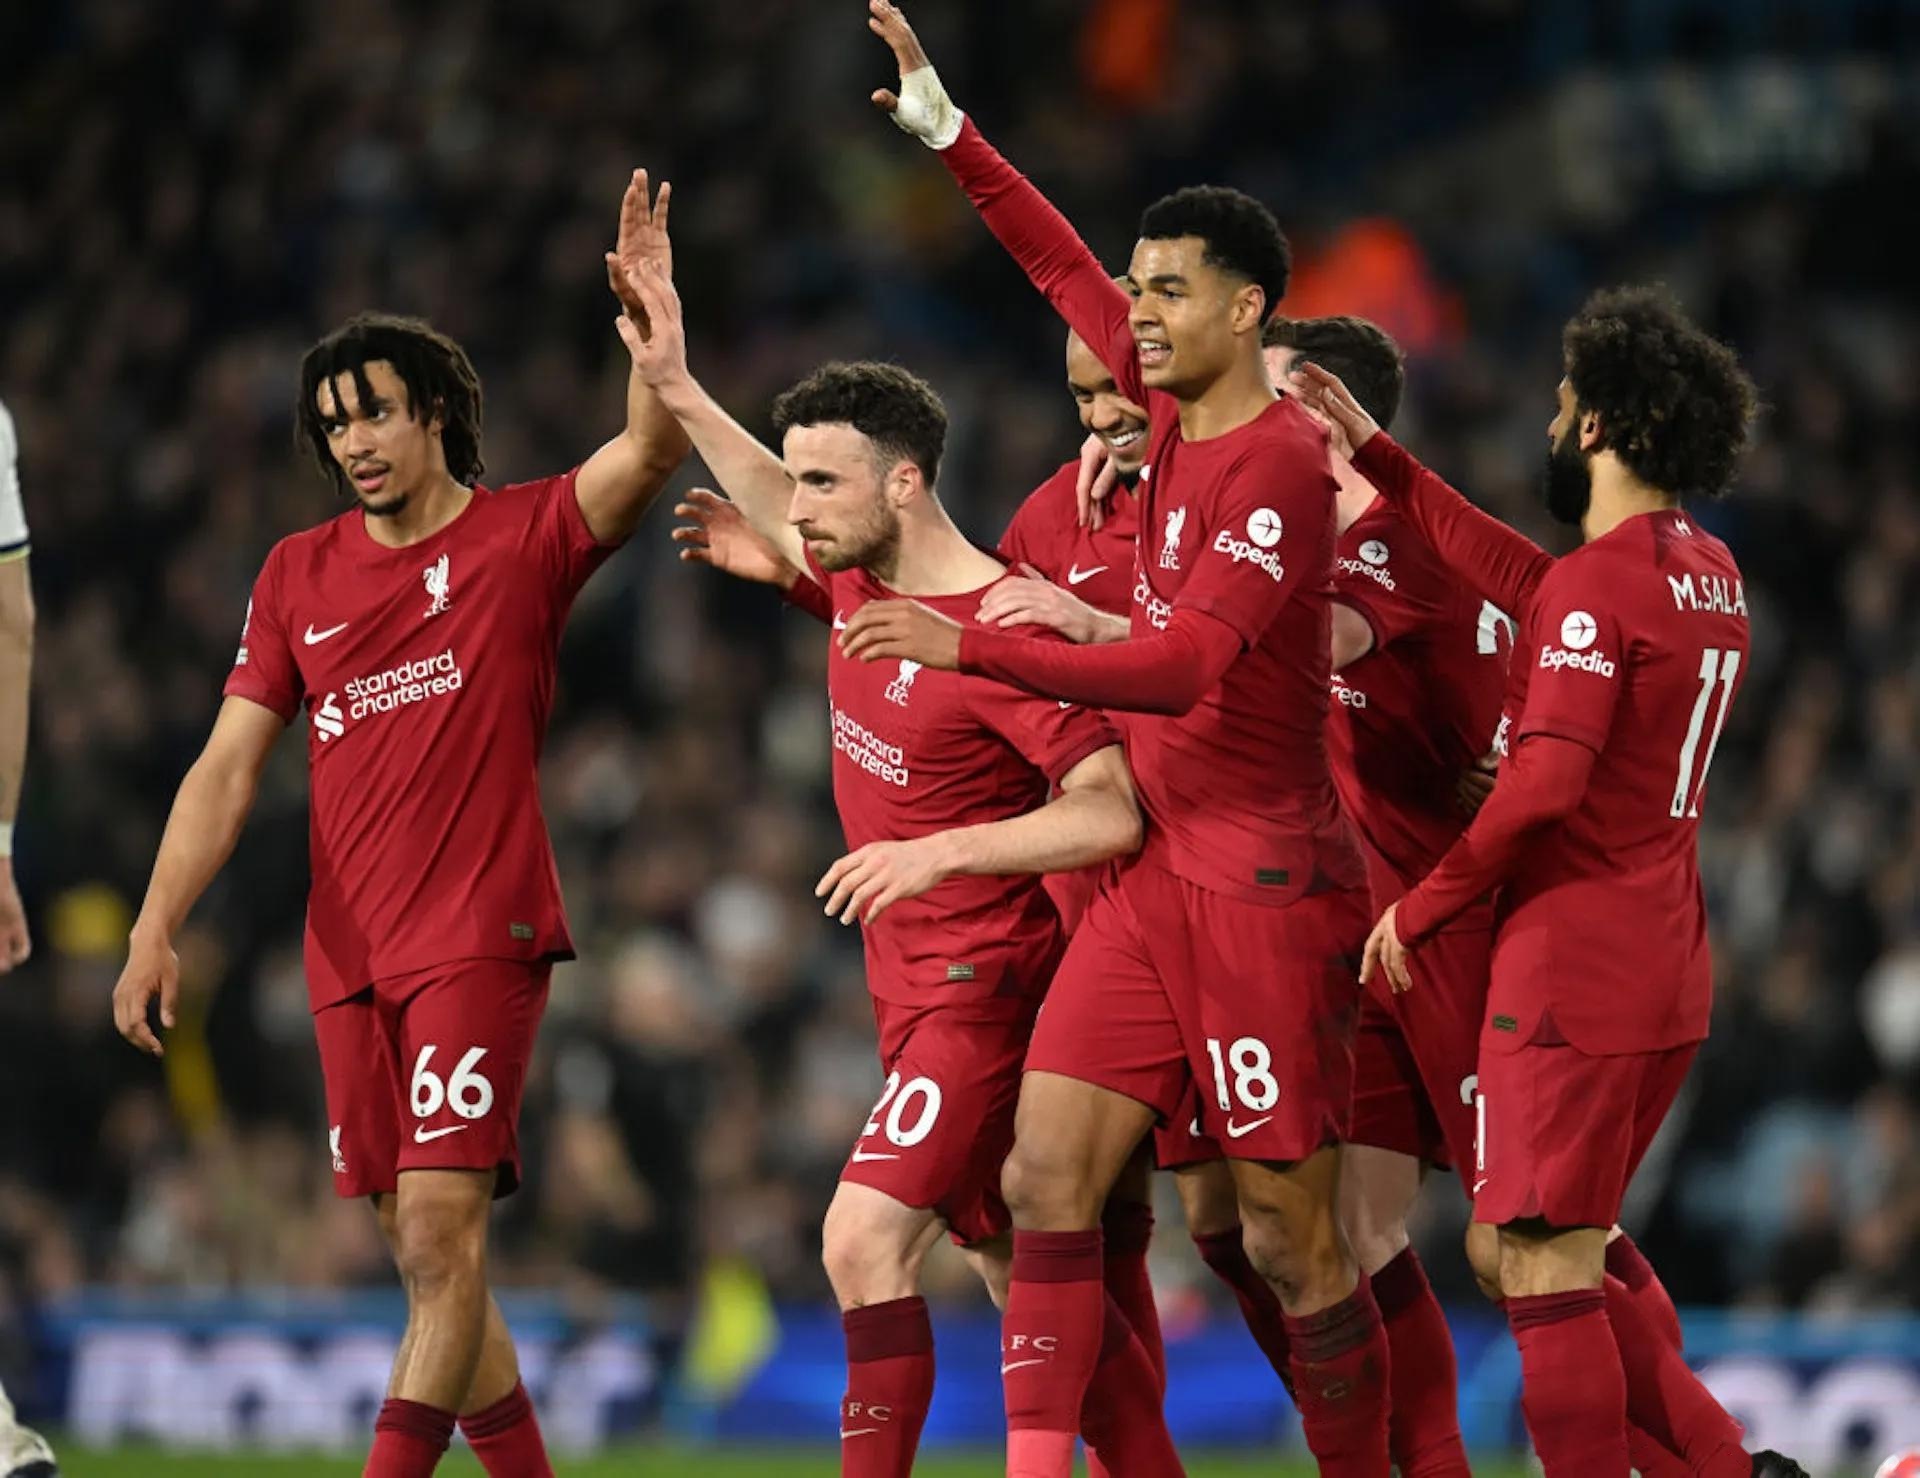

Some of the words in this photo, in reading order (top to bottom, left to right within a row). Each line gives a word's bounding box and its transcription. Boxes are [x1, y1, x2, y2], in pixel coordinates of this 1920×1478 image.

[1213, 529, 1285, 583] Expedia
[344, 649, 455, 701] standard
[350, 668, 463, 720] chartered
[884, 681, 910, 707] LFC
[1669, 648, 1741, 818] 11
[410, 1045, 494, 1120] 66
[1206, 1036, 1280, 1112] 18
[862, 1070, 942, 1147] 20
[1001, 1334, 1059, 1352] FC
[840, 1402, 892, 1421] FC
